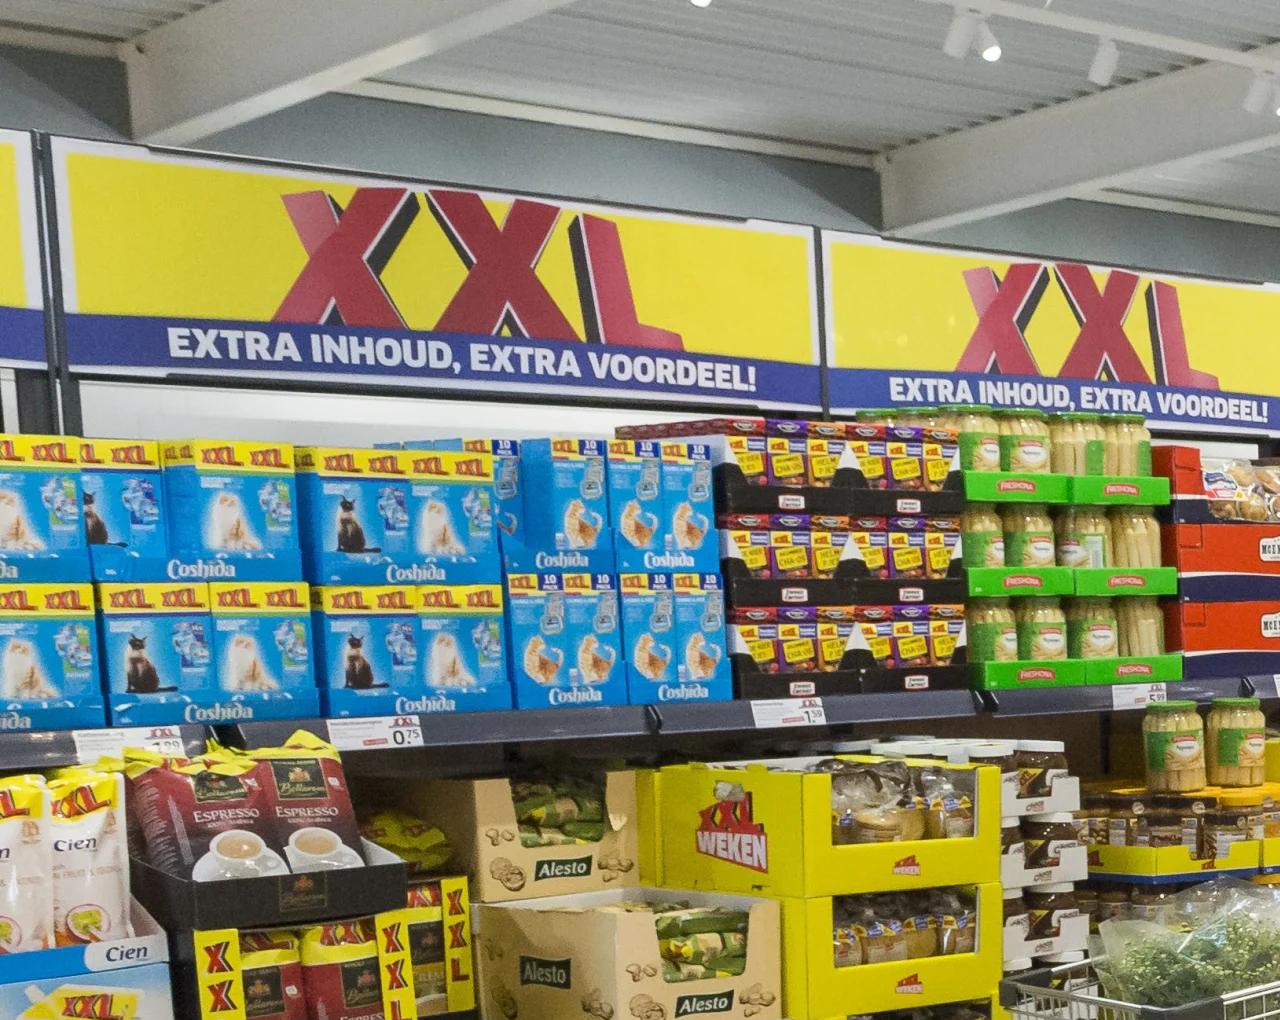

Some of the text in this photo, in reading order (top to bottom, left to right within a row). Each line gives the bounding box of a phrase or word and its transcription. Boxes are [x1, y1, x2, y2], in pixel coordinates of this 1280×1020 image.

[273, 187, 684, 351] XXL
[955, 263, 1220, 390] XXL
[167, 327, 757, 394] EXTRA INHOUD, EXTRA VOORDEEL!
[889, 376, 1269, 423] EXTRA INHOUD, EXTRA VOORDEEL!
[31, 443, 76, 463] XXL
[584, 440, 597, 450] 10
[693, 444, 705, 454] 10
[201, 446, 244, 466] XXL
[324, 454, 363, 474] XXL
[412, 456, 450, 476] XXL
[167, 559, 236, 579] Coshida
[535, 551, 589, 569] Coshida
[644, 551, 695, 569] Coshida
[386, 562, 446, 583] Coshida
[544, 575, 557, 584] 10
[705, 575, 717, 584] 10
[45, 590, 90, 610] XXL
[110, 588, 155, 609] XXL
[217, 588, 261, 609] XXL
[332, 590, 372, 610] XXL
[422, 589, 462, 610] XXL
[466, 590, 504, 609] XXL
[548, 687, 603, 706] Coshida
[658, 684, 709, 701] Coshida
[184, 704, 254, 726] Coshida
[395, 696, 456, 715] Coshida
[804, 710, 823, 724] 1.59
[393, 729, 420, 747] 0.75
[52, 784, 111, 819] XXL
[193, 807, 261, 823] ESPRESSO
[275, 805, 339, 819] ESPRESSO
[700, 791, 764, 834] XXL
[53, 836, 98, 853] Cien
[697, 831, 769, 871] WEKEN
[537, 858, 589, 878] Alesto
[105, 944, 148, 963] Cien
[523, 961, 567, 985] Alesto
[680, 996, 729, 1013] Alesto
